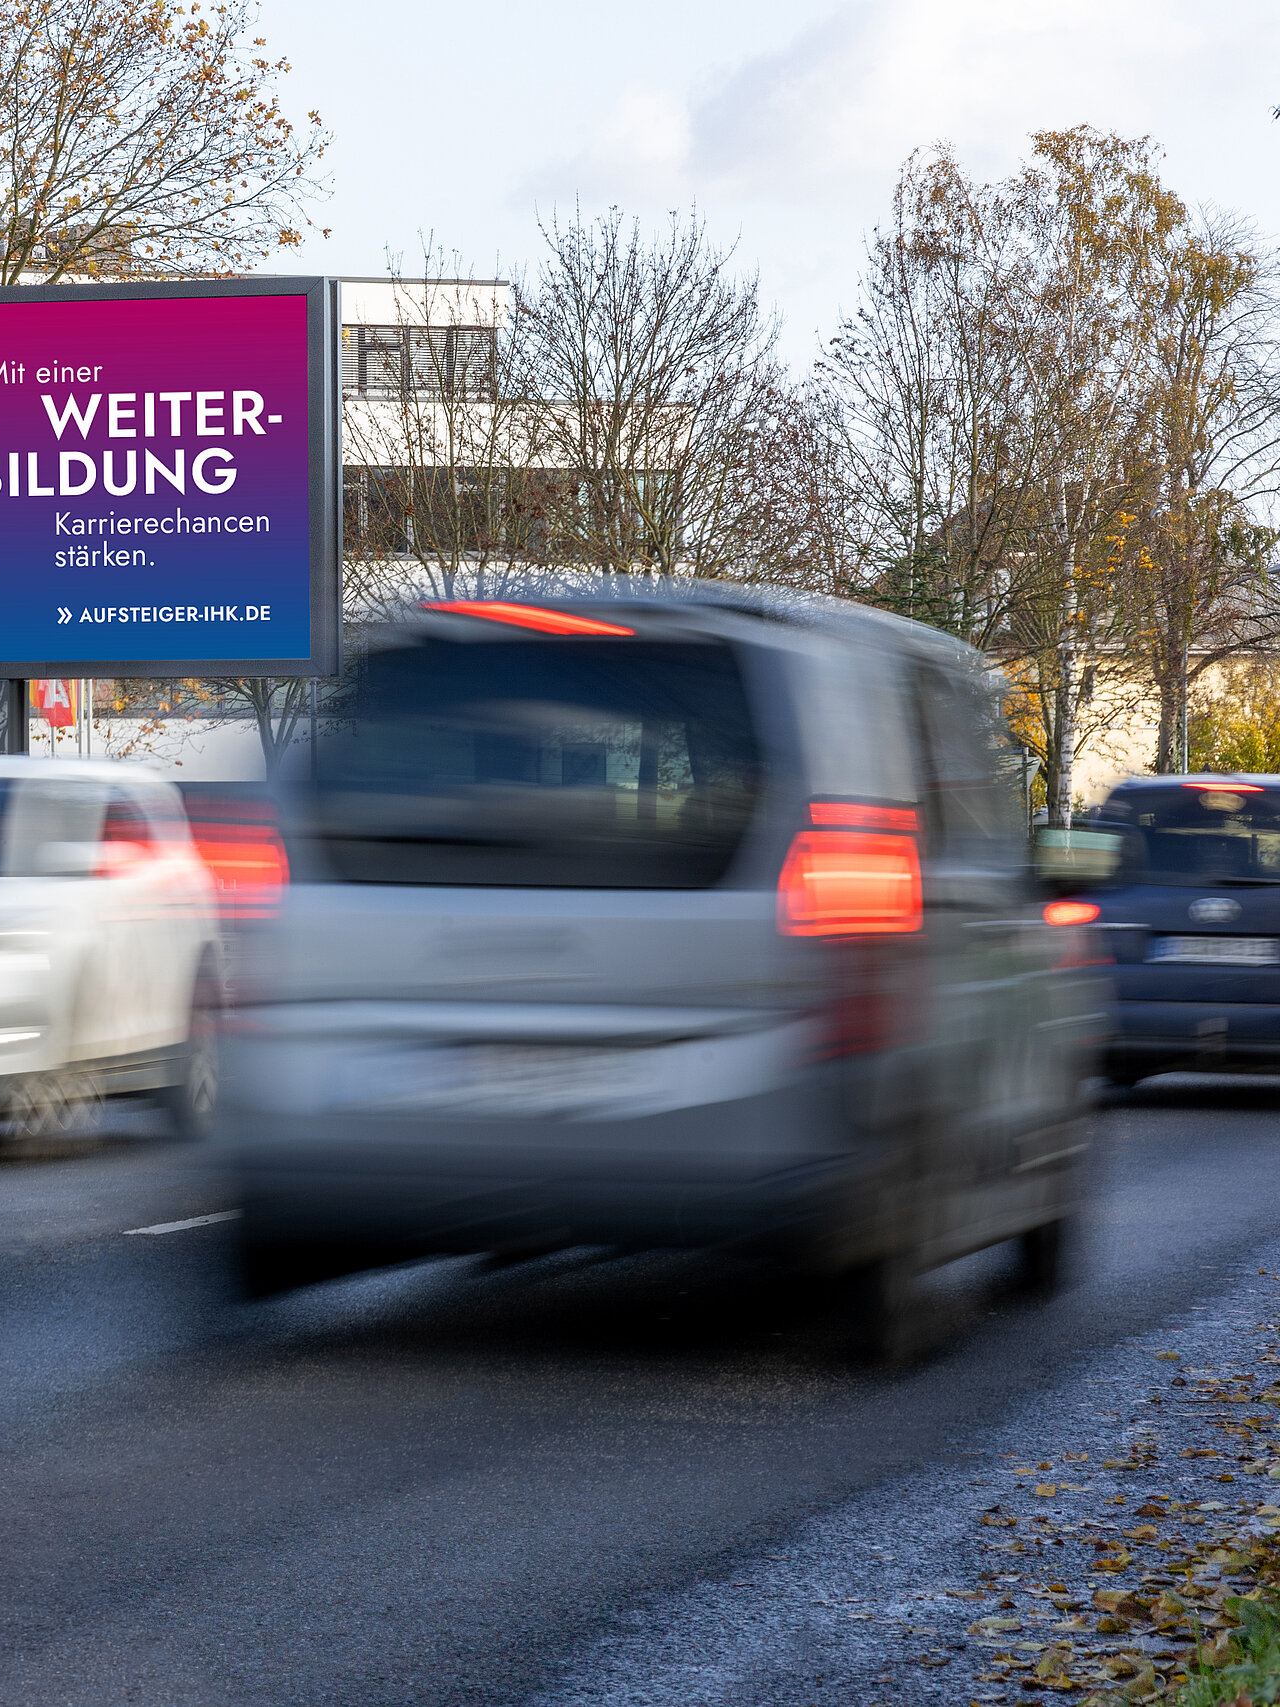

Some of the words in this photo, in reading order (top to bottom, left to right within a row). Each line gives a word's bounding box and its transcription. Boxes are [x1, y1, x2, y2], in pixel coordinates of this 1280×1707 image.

[36, 359, 103, 384] einer
[40, 390, 283, 441] WEITER-
[55, 507, 270, 536] Karrierechancen
[55, 540, 155, 568] stärken.
[79, 605, 271, 623] AUFSTEIGER-IHK.DE
